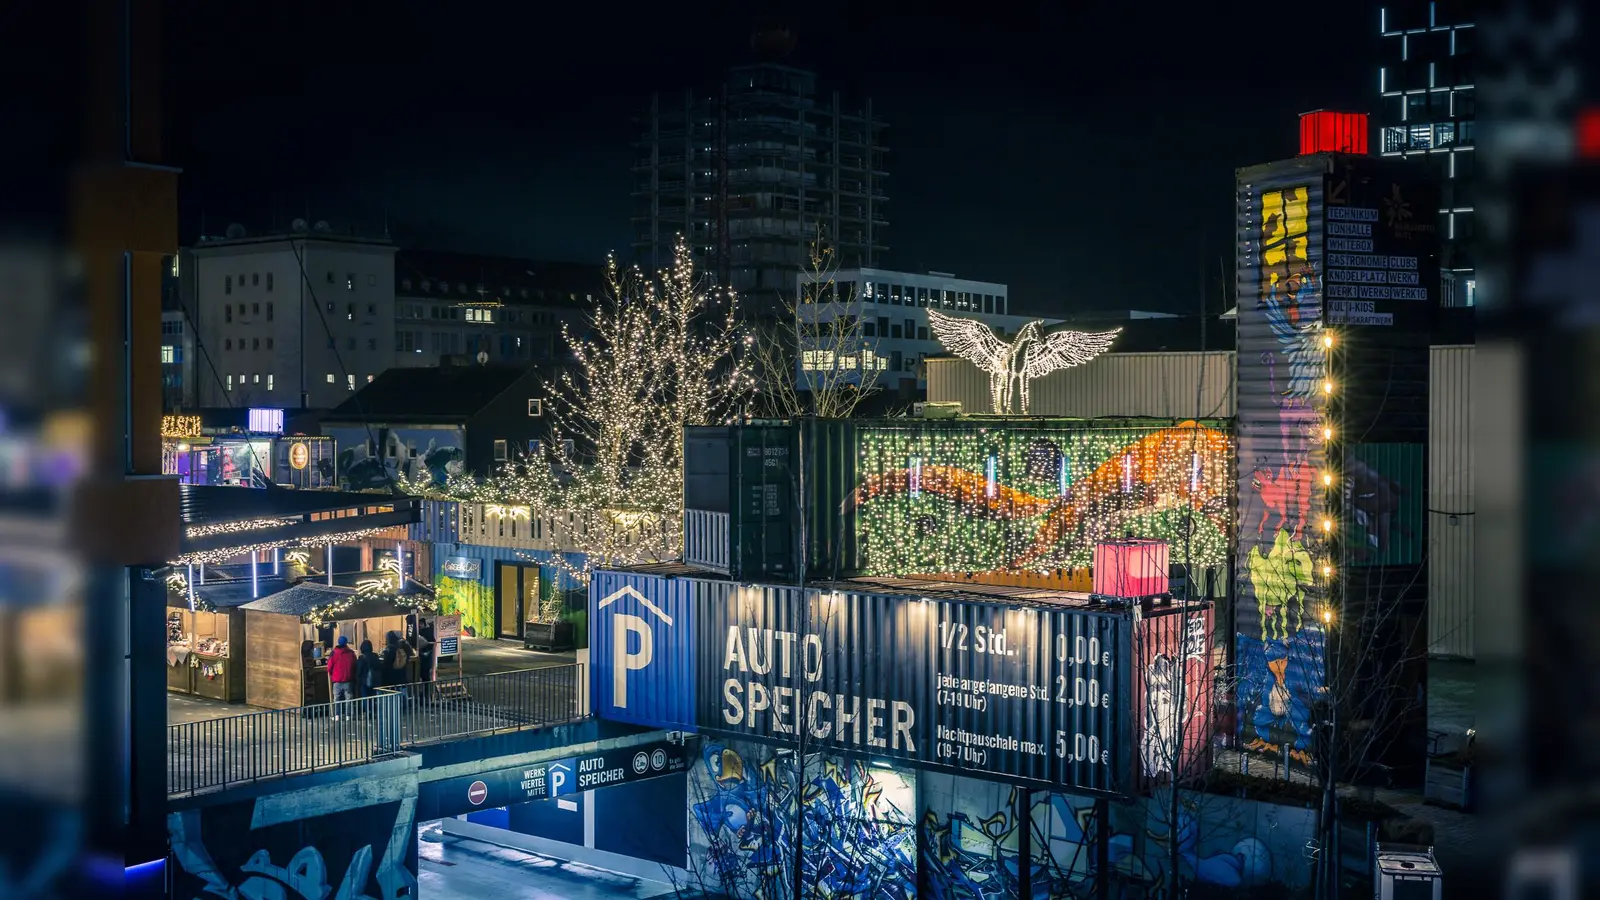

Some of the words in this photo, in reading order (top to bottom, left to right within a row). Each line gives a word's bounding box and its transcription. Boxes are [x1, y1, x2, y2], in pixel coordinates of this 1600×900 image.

[1329, 208, 1377, 220] TECHNIKUM
[1329, 224, 1371, 235] TONHALLE
[1329, 239, 1372, 250] WHITEBOX
[1329, 254, 1387, 267] GASTRONOMIE
[1391, 257, 1416, 268] CLUBS
[1388, 272, 1418, 284] WERK7
[1328, 286, 1357, 296] WERK1
[1360, 287, 1390, 298] WERK9
[1392, 288, 1426, 299] WERK10
[937, 621, 968, 651] 1/2
[614, 613, 653, 709] P
[724, 625, 823, 682] AUTO
[937, 672, 959, 690] jede
[960, 678, 1028, 699] angefangene
[1029, 684, 1050, 701] Std.
[964, 694, 987, 713] Uhr)
[722, 678, 916, 752] SPEICHER
[937, 724, 1018, 752] Nachtpauschale
[1020, 740, 1047, 756] max.
[655, 754, 663, 765] 10
[964, 746, 987, 766] Uhr)
[579, 757, 604, 773] AUTO
[523, 767, 546, 780] WERKS
[579, 768, 624, 787] SPEICHER
[520, 778, 546, 790] VIERTEL
[527, 787, 546, 797] MITTE
[552, 771, 565, 797] P
